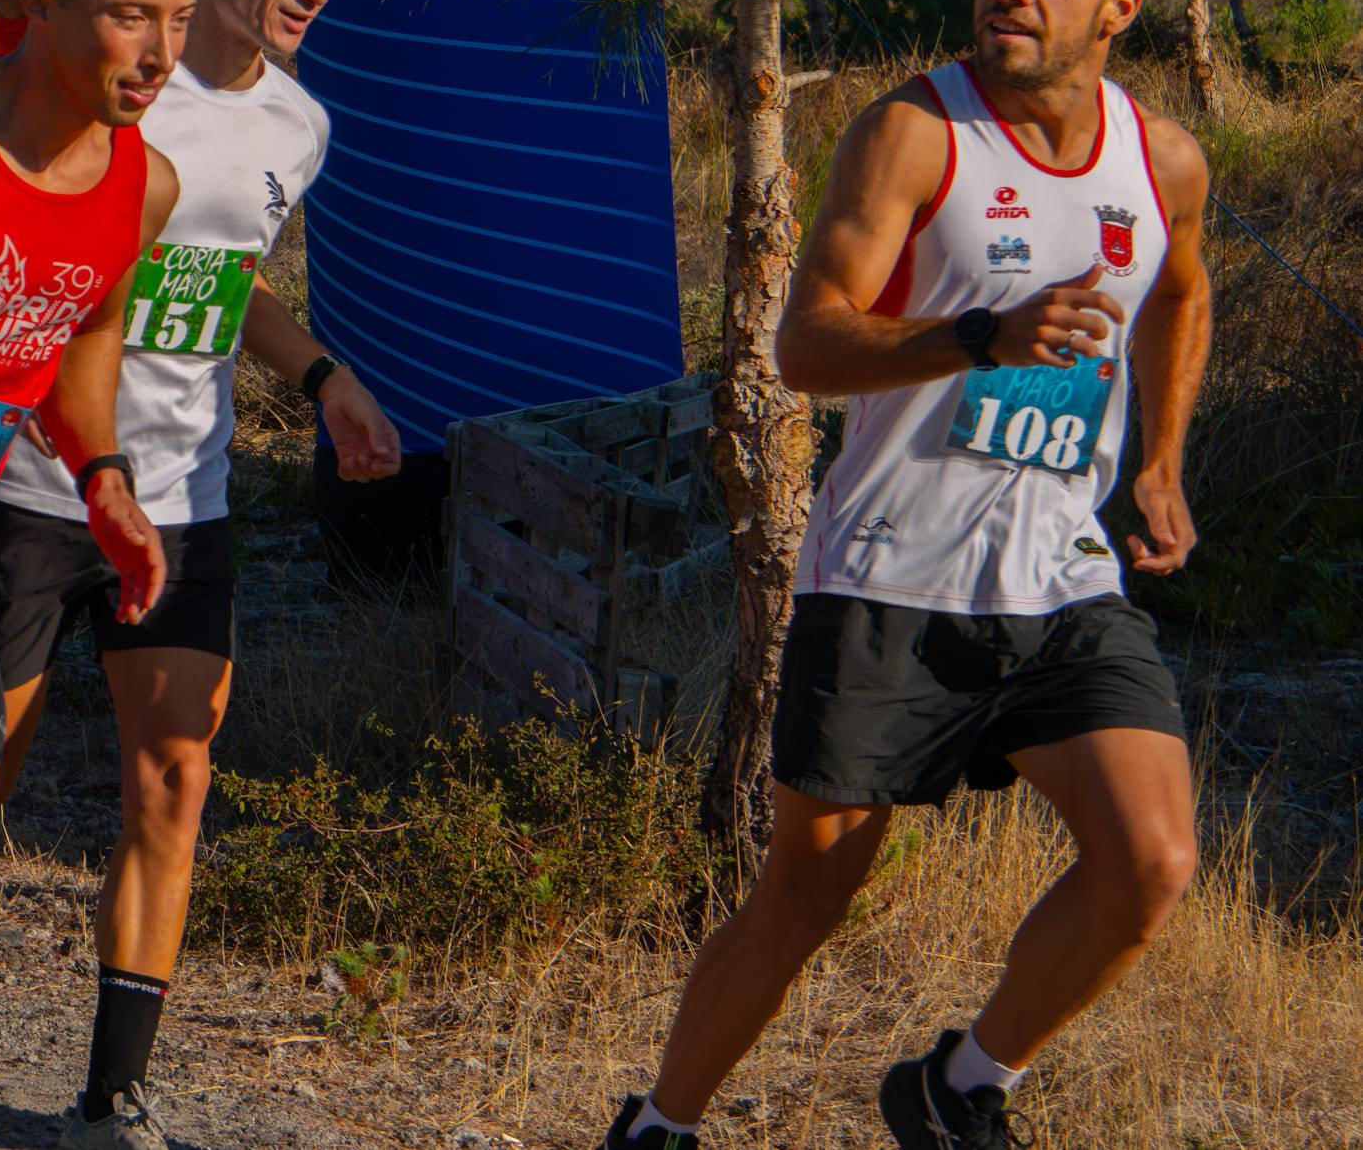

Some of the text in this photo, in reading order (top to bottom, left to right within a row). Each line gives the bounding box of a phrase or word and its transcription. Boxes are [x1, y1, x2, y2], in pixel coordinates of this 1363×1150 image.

[40, 261, 94, 300] 39
[122, 298, 224, 353] 151
[967, 397, 1086, 470] 108
